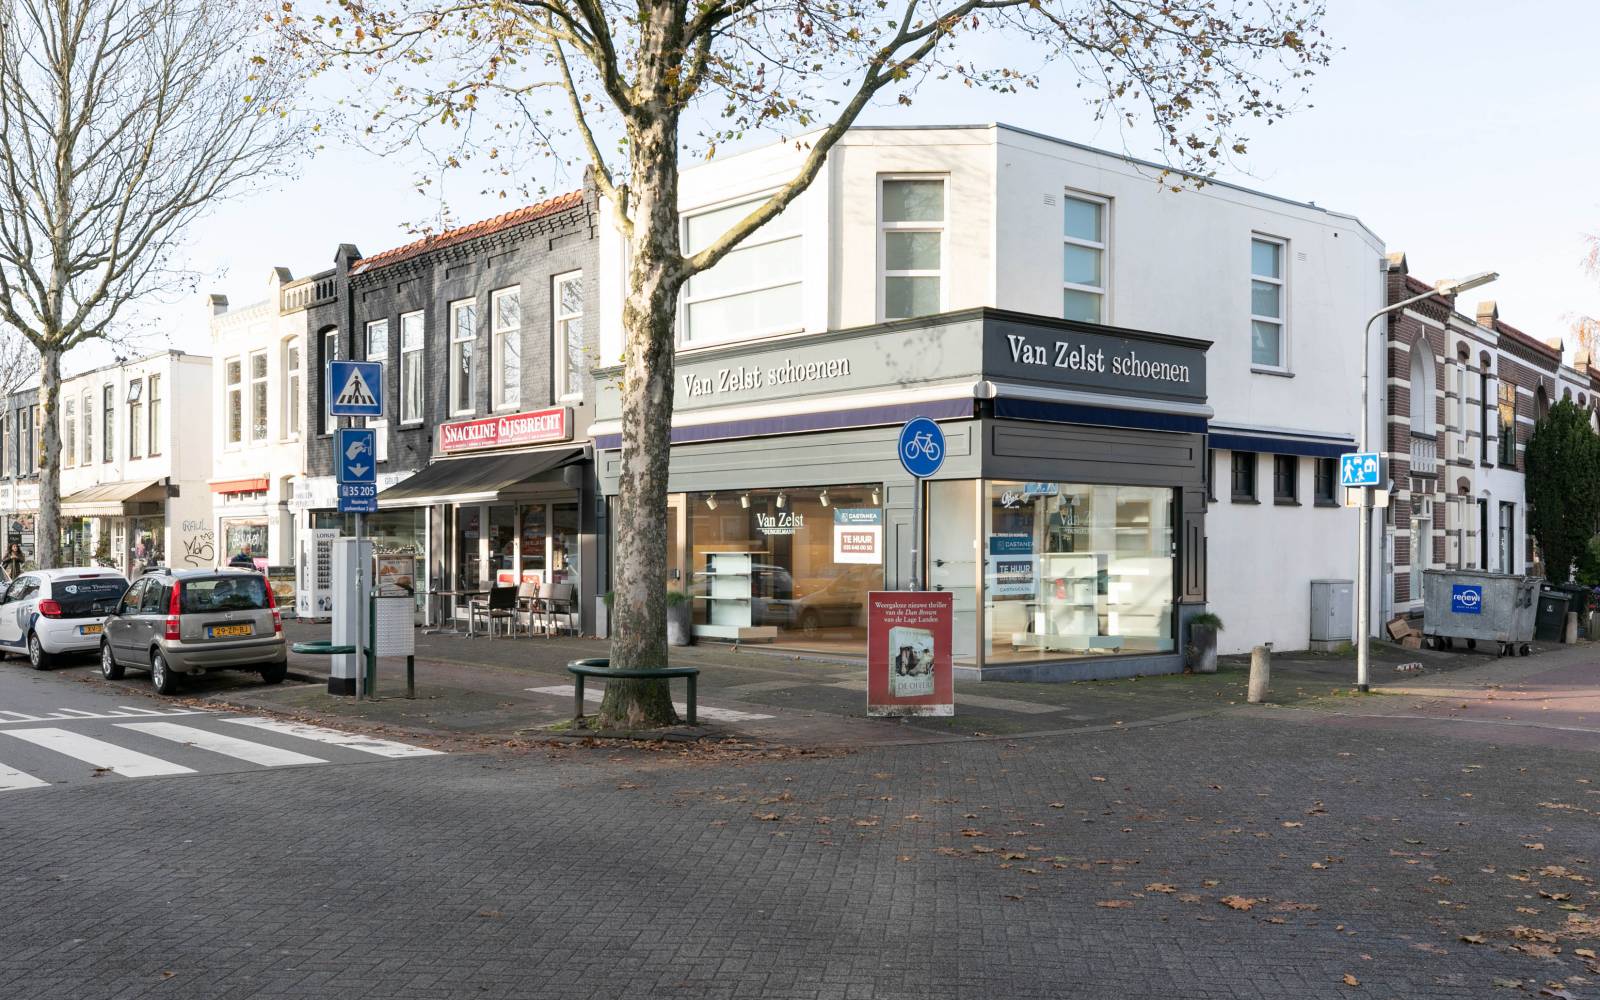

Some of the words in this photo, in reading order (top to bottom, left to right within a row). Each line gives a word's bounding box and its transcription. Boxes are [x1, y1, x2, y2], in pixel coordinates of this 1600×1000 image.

[1007, 334, 1048, 366] Van
[1054, 341, 1105, 373] Zelst
[1112, 351, 1190, 383] schoenen
[682, 373, 713, 397] Van
[717, 365, 762, 393] Zelst
[767, 357, 851, 386] schoenen
[445, 422, 496, 443] SNACKLINE
[498, 413, 561, 437] GIJSBRECHT
[349, 486, 359, 496] 35
[360, 486, 375, 496] 205
[756, 512, 776, 527] Van
[778, 512, 804, 527] Zelst
[843, 535, 852, 544] TE
[852, 535, 873, 544] HUUR
[999, 565, 1009, 573] TE
[1010, 564, 1031, 573] HUUR
